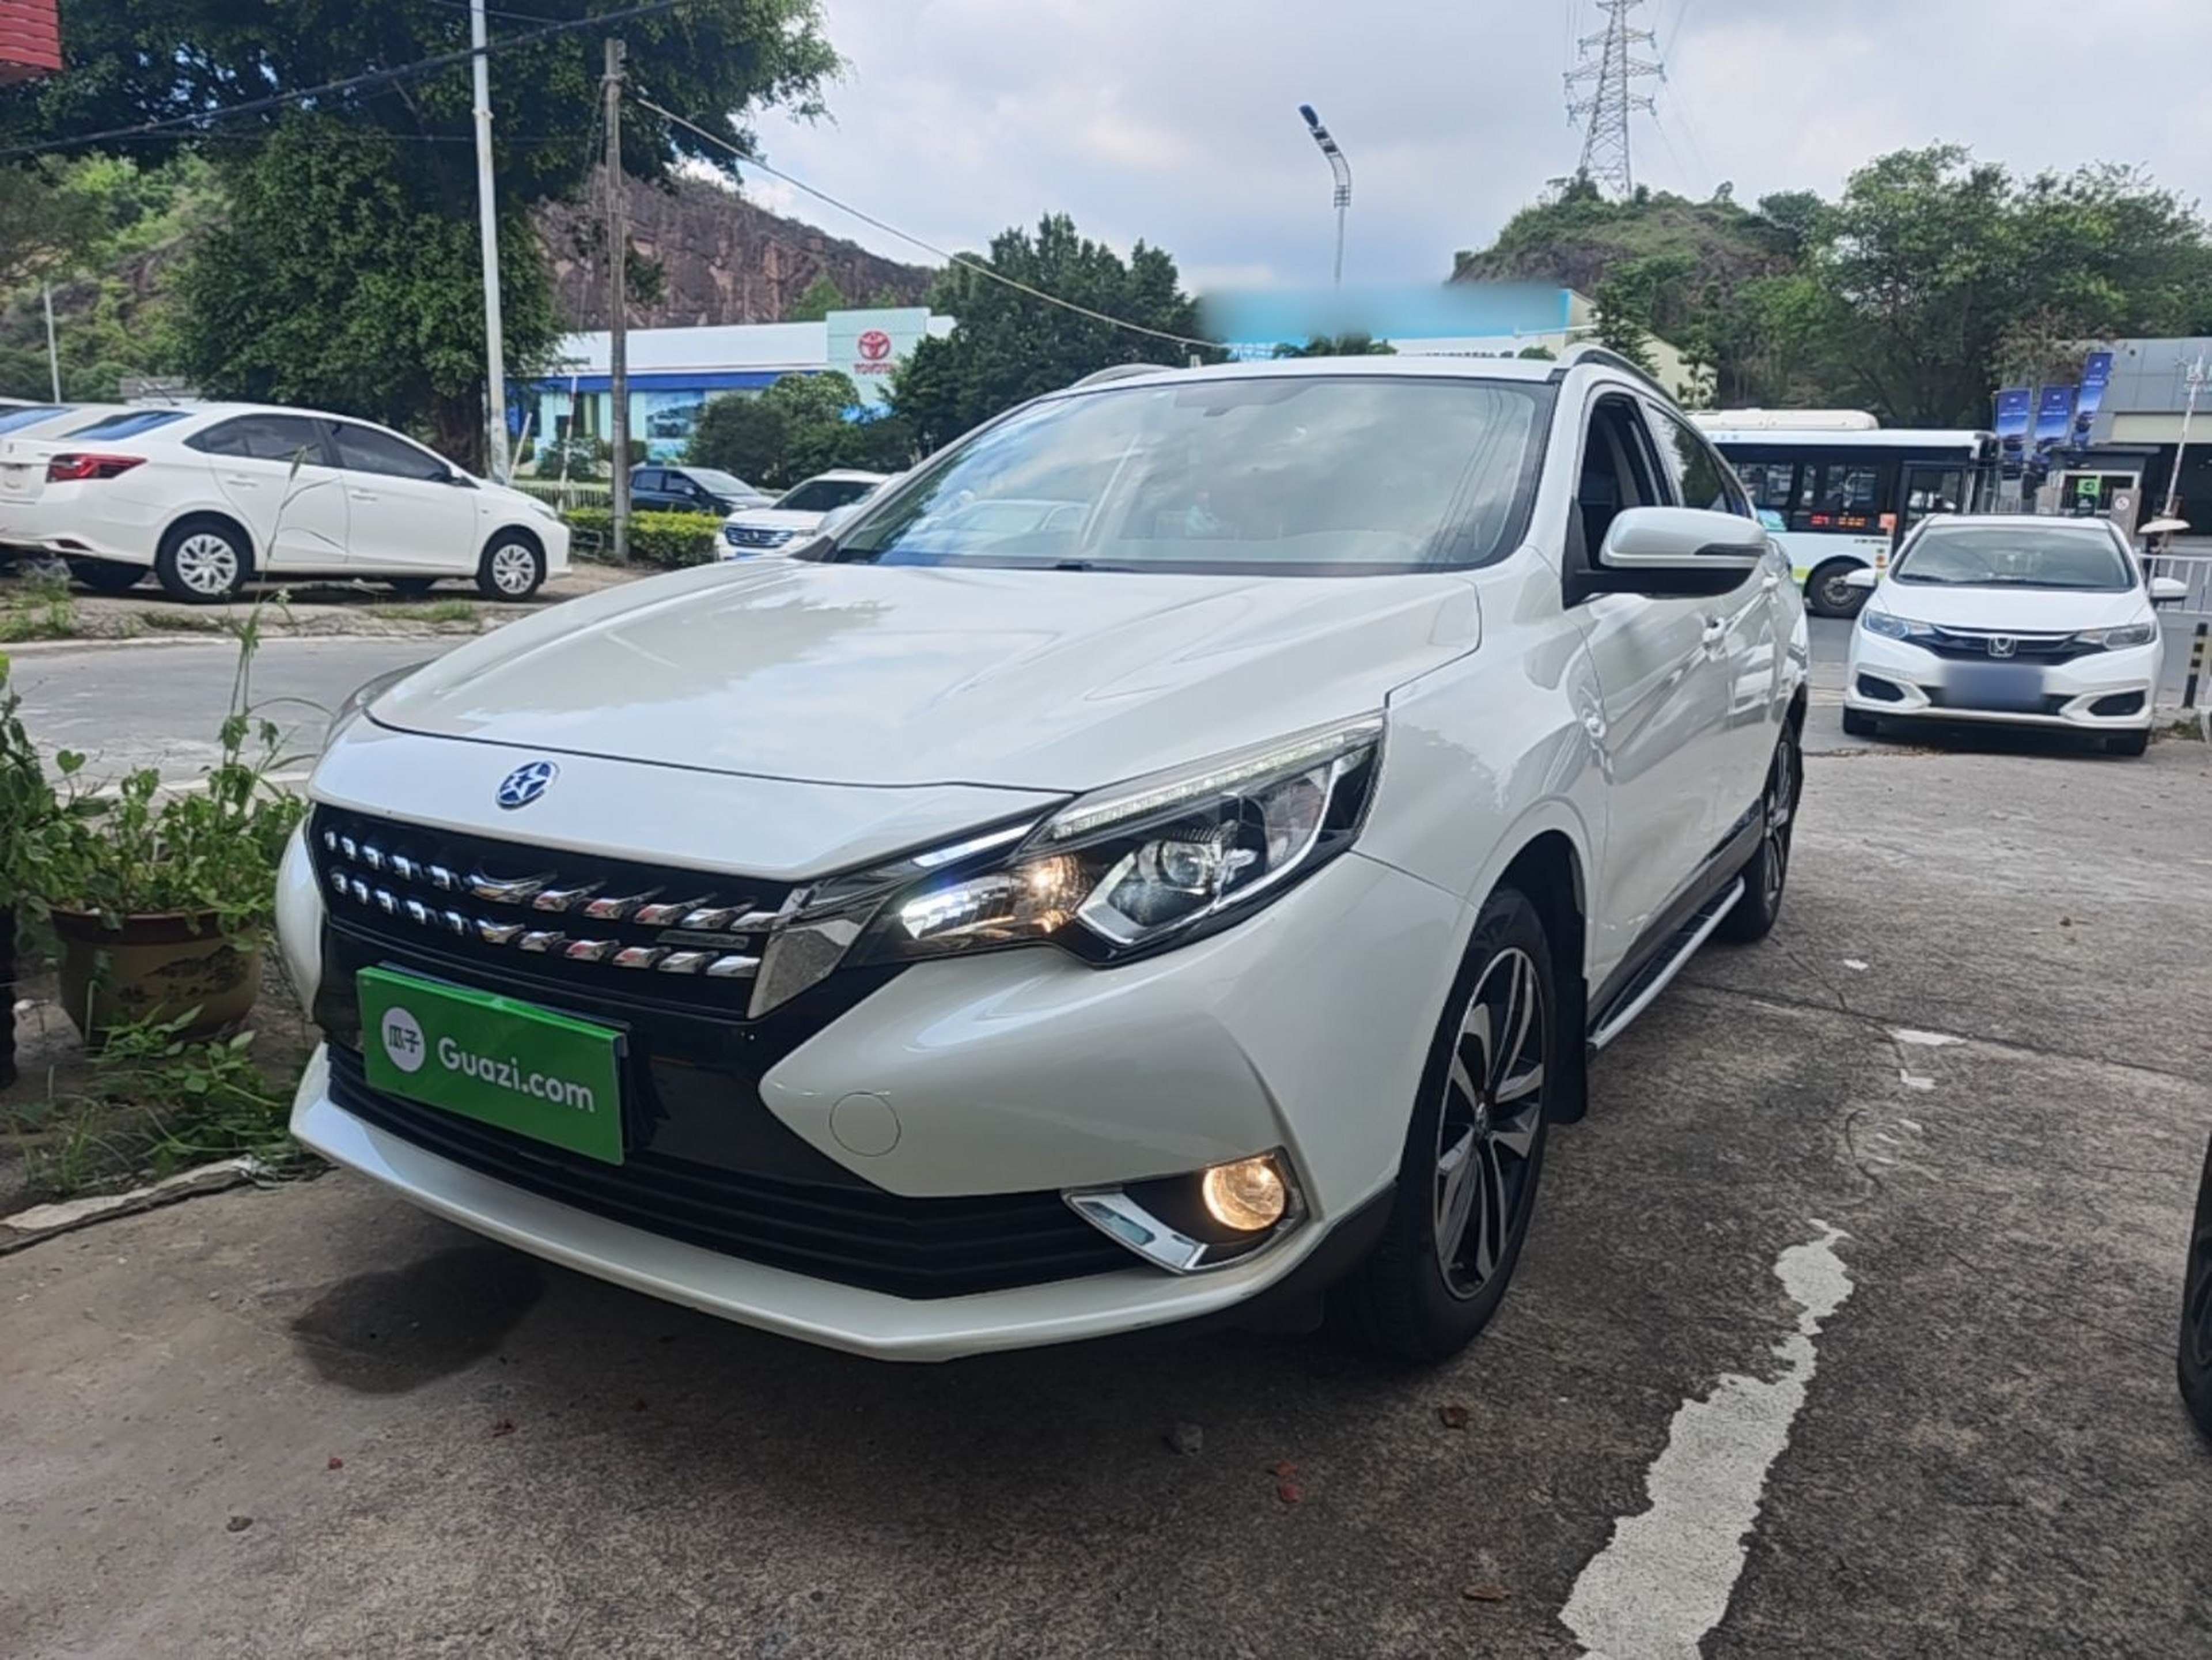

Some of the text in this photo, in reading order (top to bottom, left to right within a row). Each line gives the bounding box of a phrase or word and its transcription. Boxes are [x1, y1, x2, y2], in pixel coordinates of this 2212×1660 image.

[854, 362, 897, 375] TOYOTA
[389, 1024, 420, 1053] 瓜子
[438, 1037, 595, 1113] Guazi.com
